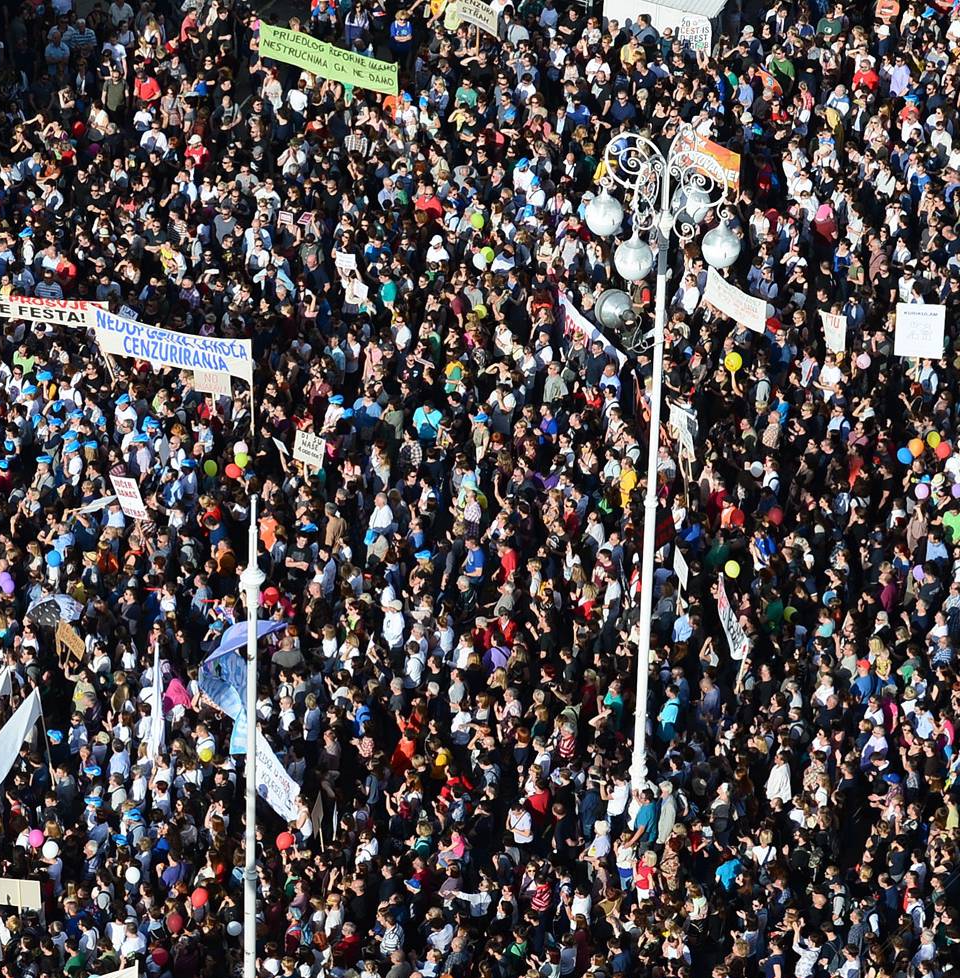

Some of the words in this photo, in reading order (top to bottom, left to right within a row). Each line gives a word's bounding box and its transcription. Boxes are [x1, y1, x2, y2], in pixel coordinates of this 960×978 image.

[464, 0, 495, 16] ENZURA
[273, 30, 324, 52] PRIJEDLOG
[334, 63, 347, 73] GA
[353, 69, 364, 78] NE
[369, 74, 394, 86] DAMO
[123, 335, 229, 372] CENZURIRANJA
[314, 436, 323, 446] SU
